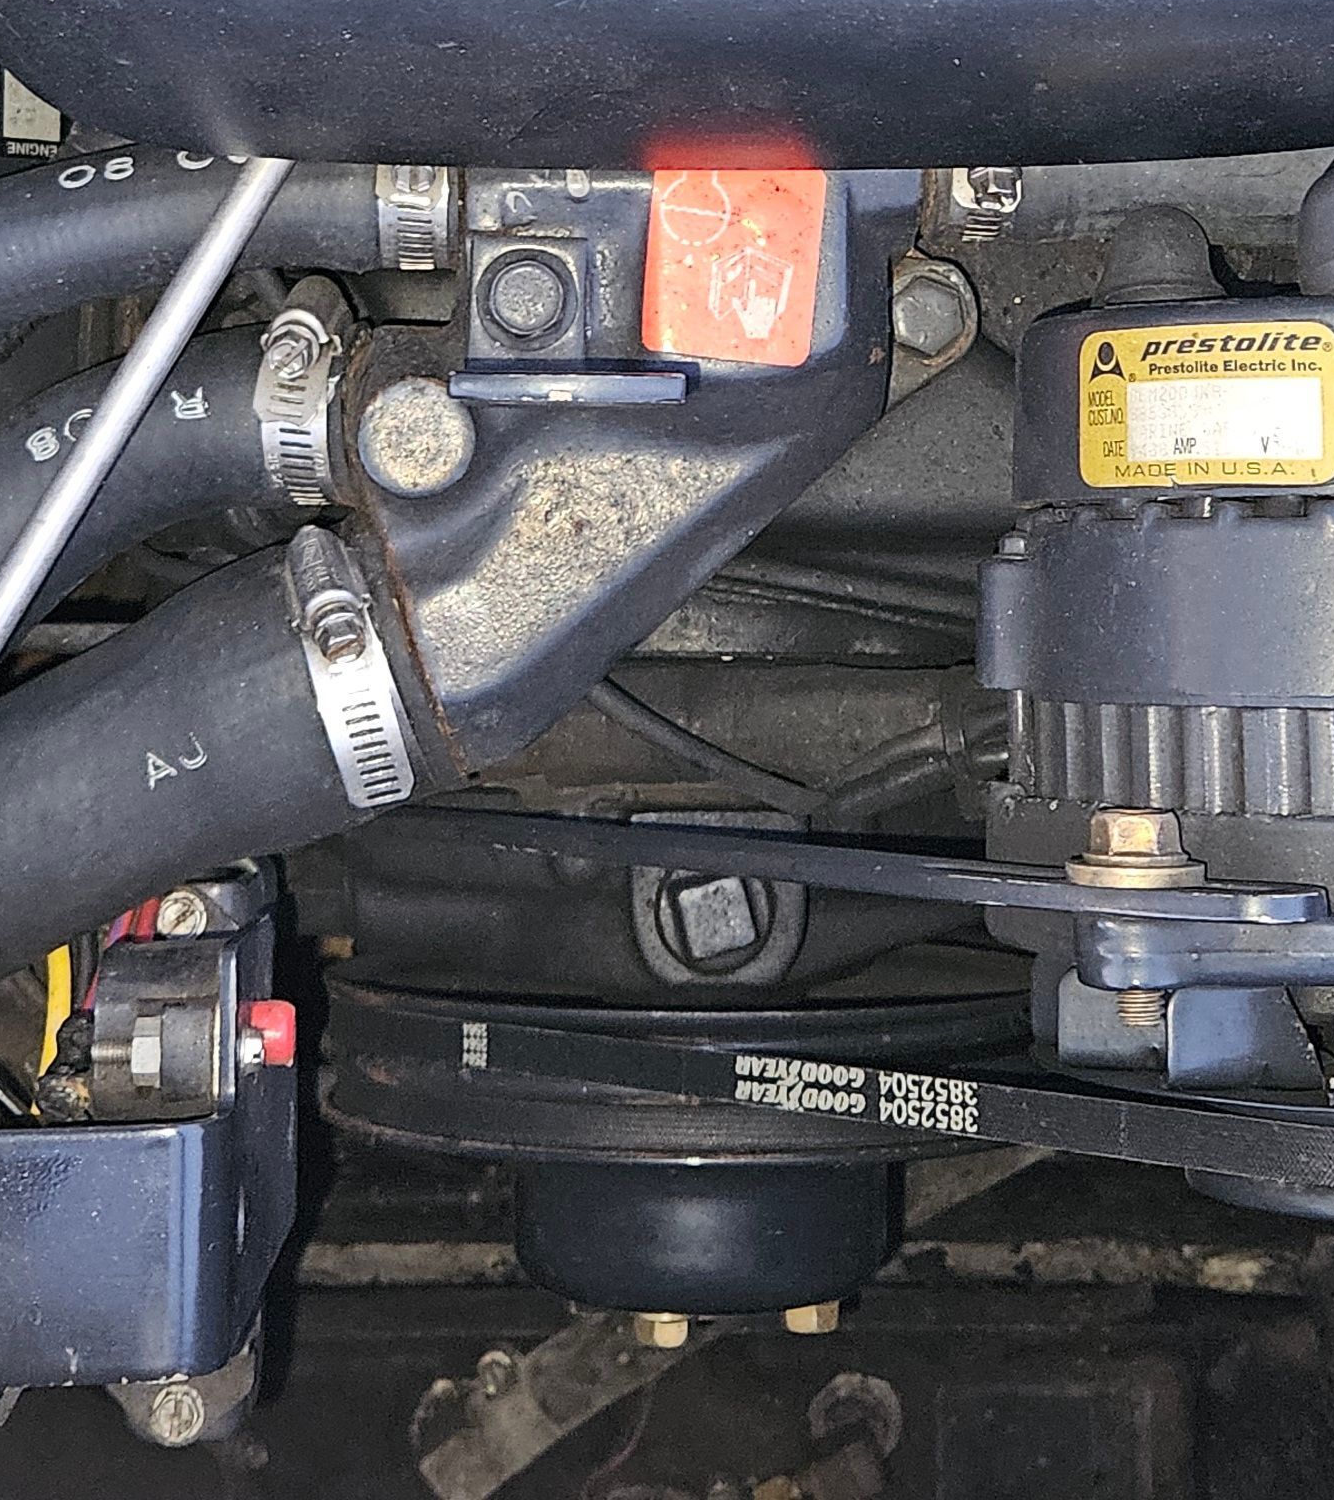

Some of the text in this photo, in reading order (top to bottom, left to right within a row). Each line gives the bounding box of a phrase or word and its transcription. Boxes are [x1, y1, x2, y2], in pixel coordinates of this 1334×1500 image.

[7, 141, 57, 158] ENGINE
[1141, 332, 1322, 362] prestolite
[1149, 359, 1323, 376] Prestolite Electric Inc.
[1088, 390, 1115, 407] MODEL
[1103, 440, 1125, 457] DATE
[1115, 461, 1295, 478] MADE IN U.S.A.
[734, 1055, 978, 1105] 3852504 GOODYEAR
[734, 1080, 979, 1133] 3852504 GOODYEAR
